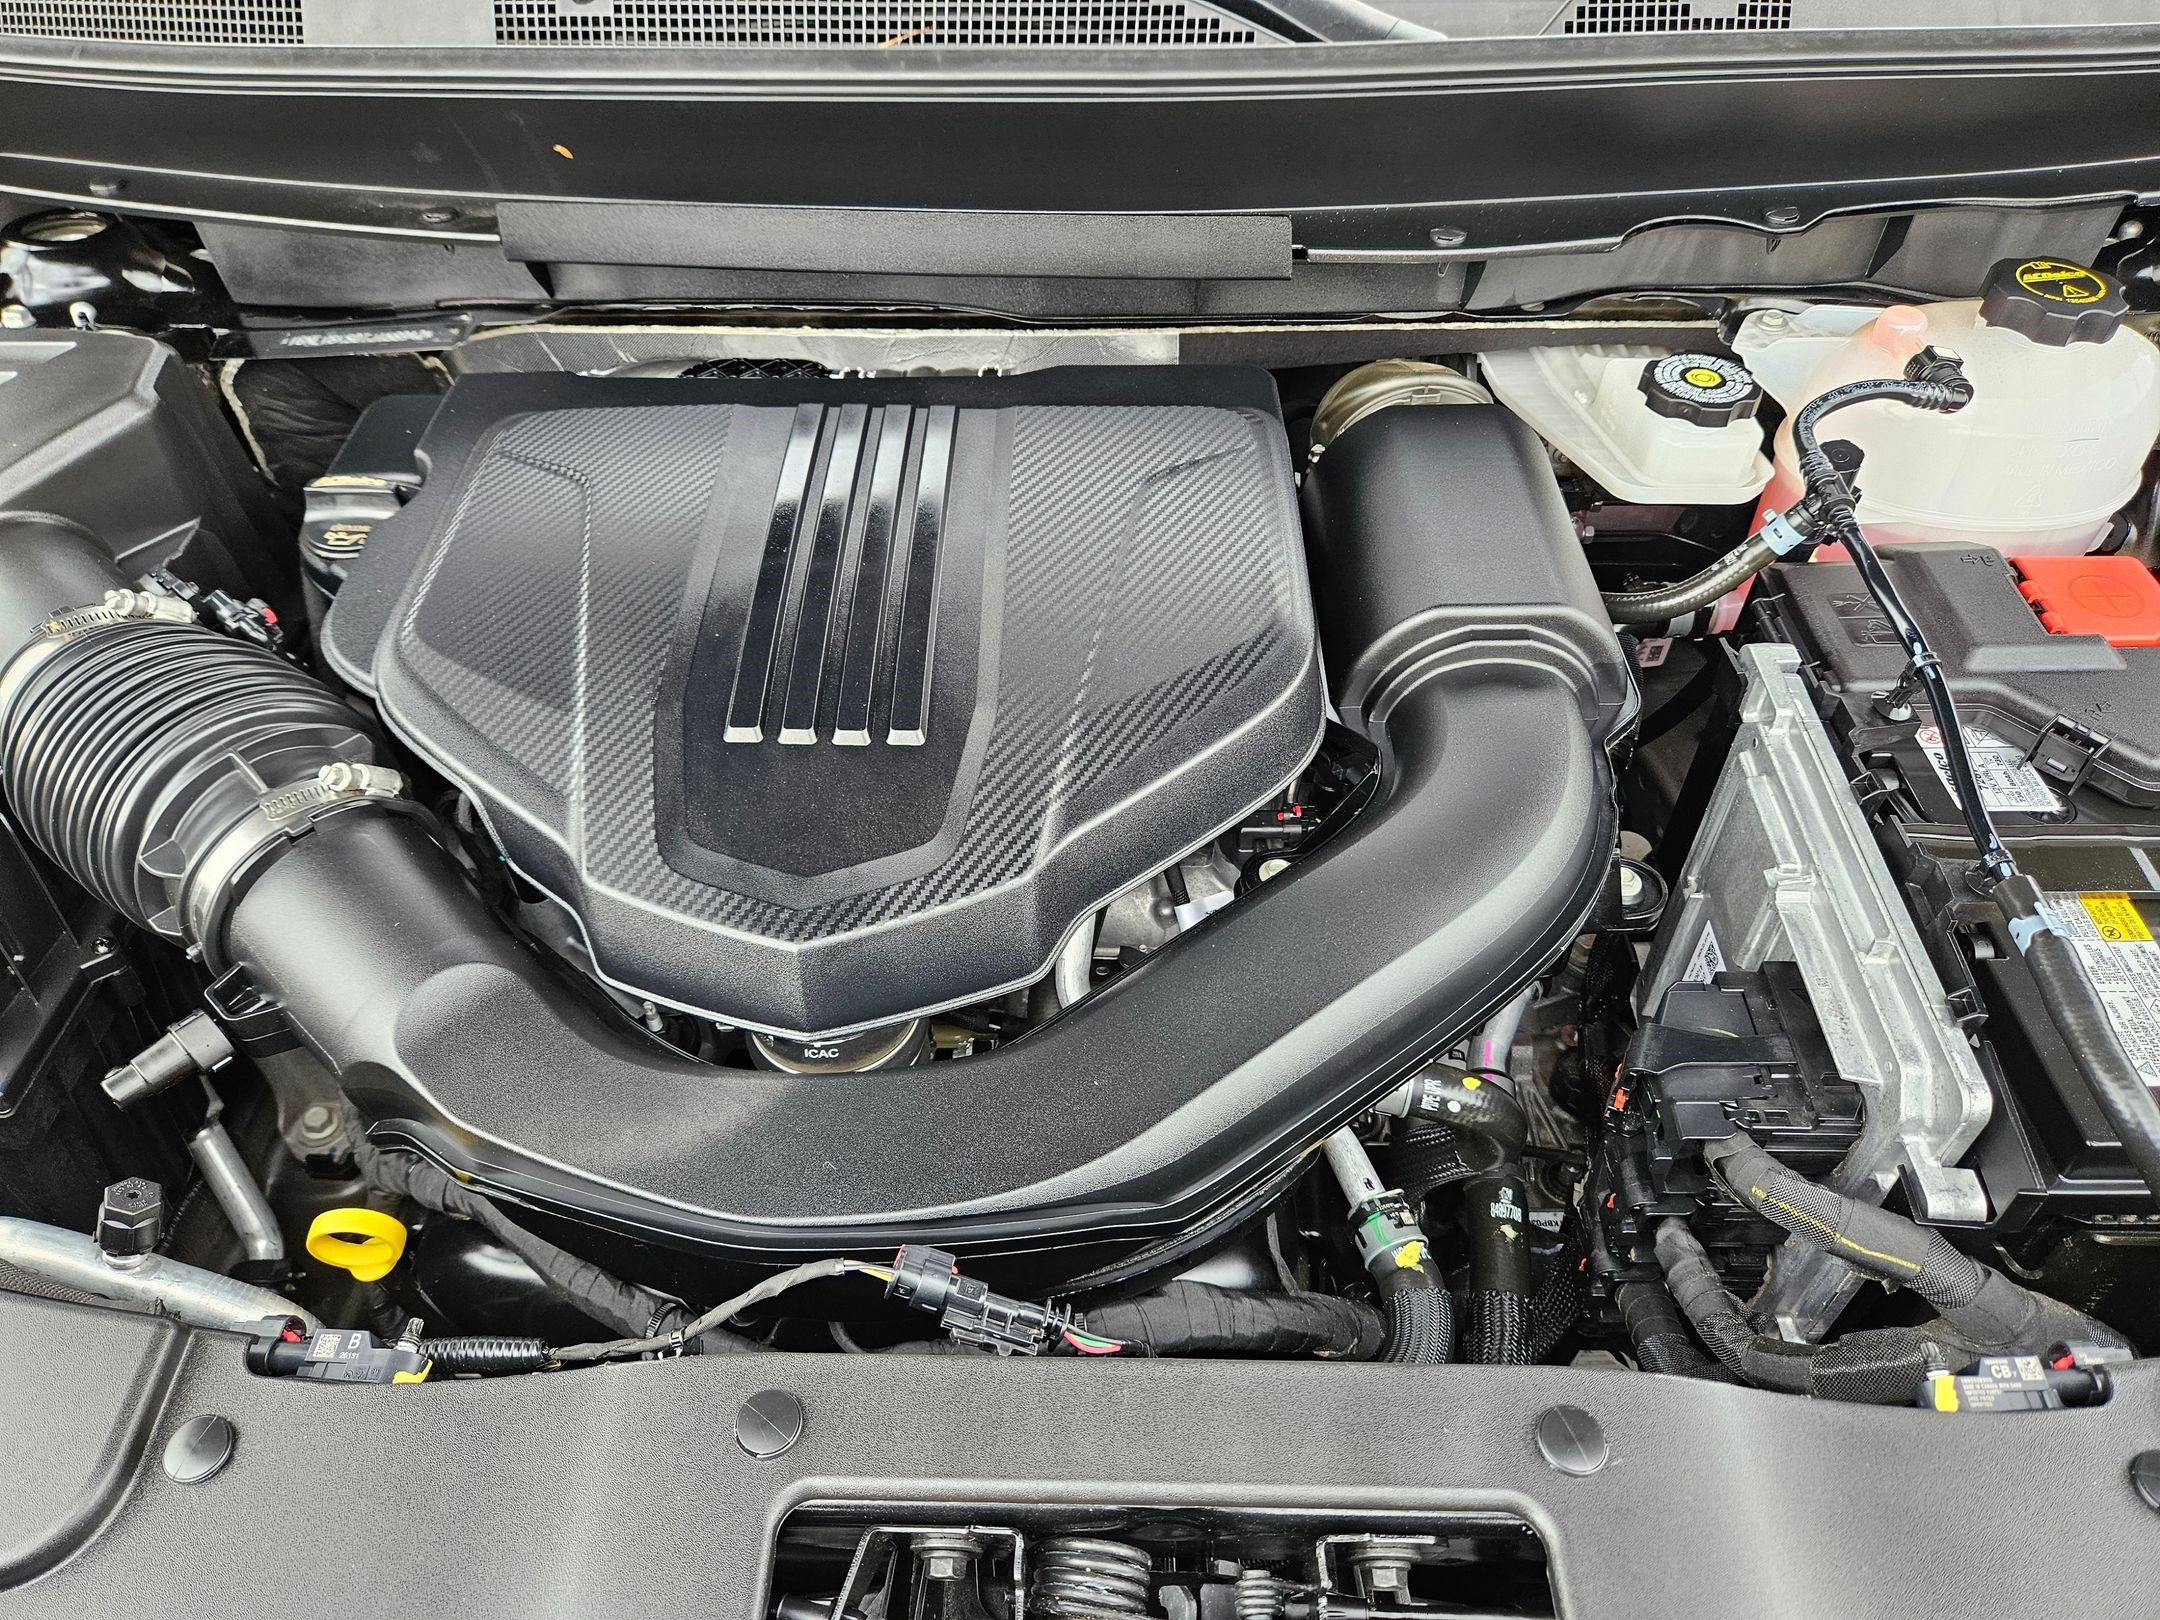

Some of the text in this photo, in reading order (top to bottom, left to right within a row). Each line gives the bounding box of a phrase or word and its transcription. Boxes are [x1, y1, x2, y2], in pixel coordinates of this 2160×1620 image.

[804, 1048, 839, 1058] ICAC
[347, 1333, 362, 1349] B
[1991, 1365, 2012, 1378] CB
